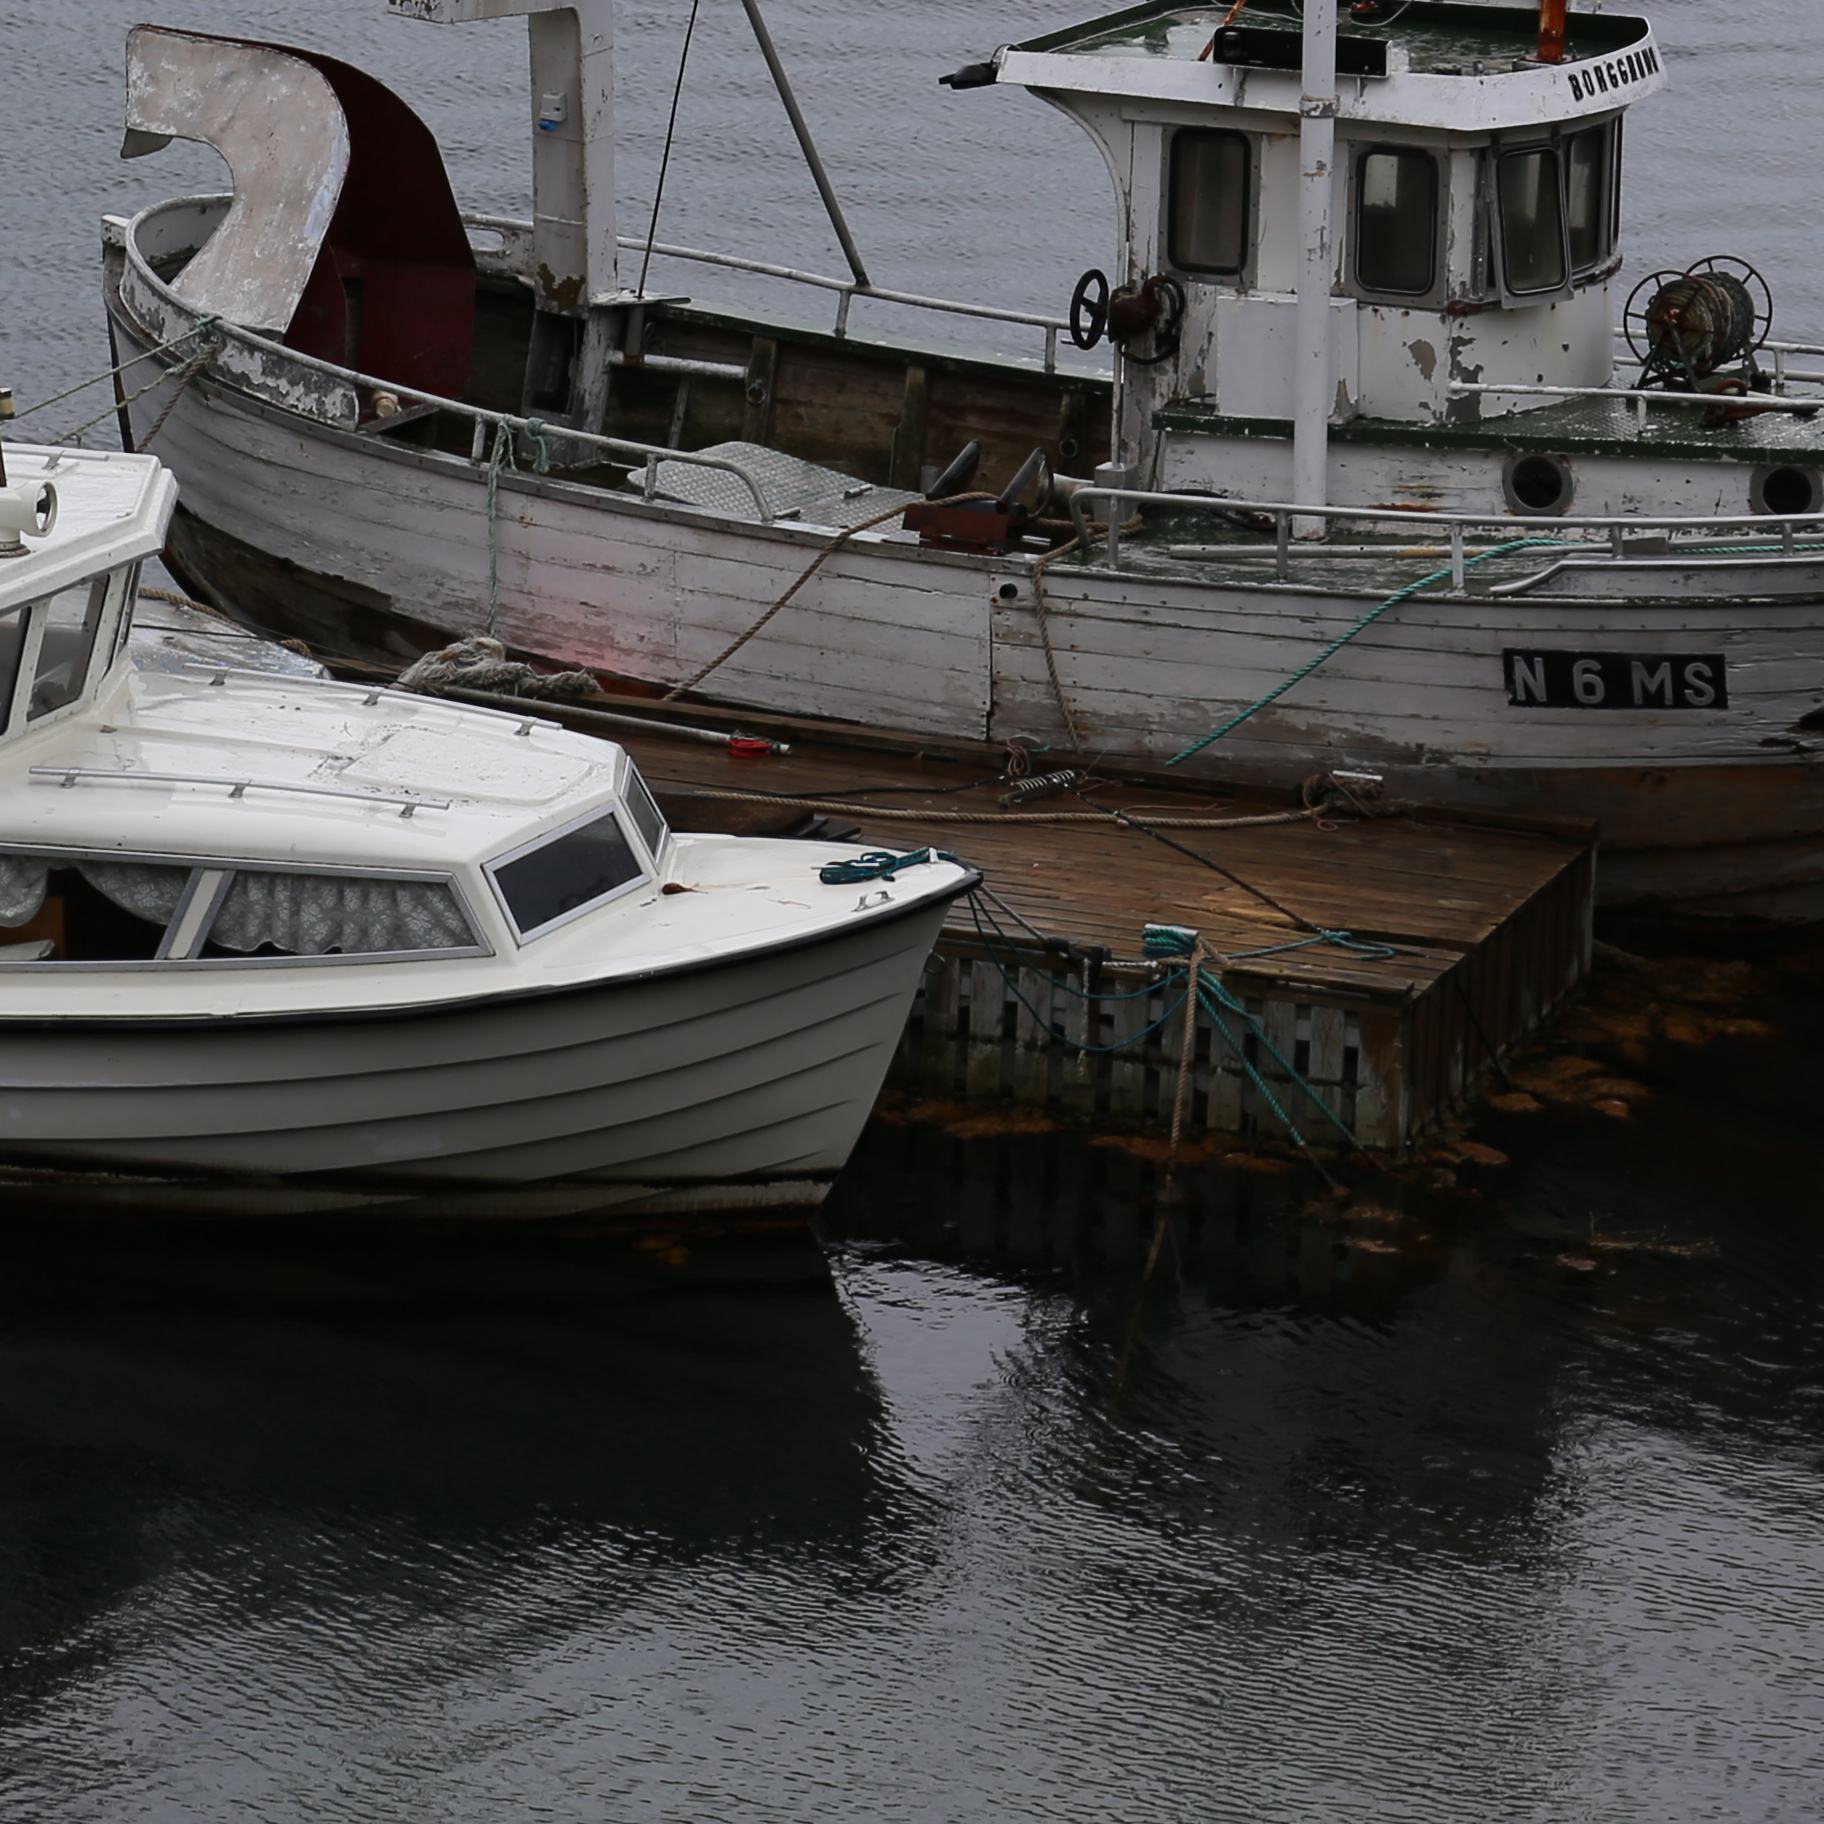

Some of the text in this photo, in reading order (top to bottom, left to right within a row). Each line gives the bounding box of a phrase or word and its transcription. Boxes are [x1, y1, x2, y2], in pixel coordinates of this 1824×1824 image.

[1513, 656, 1715, 706] N 6 MS
